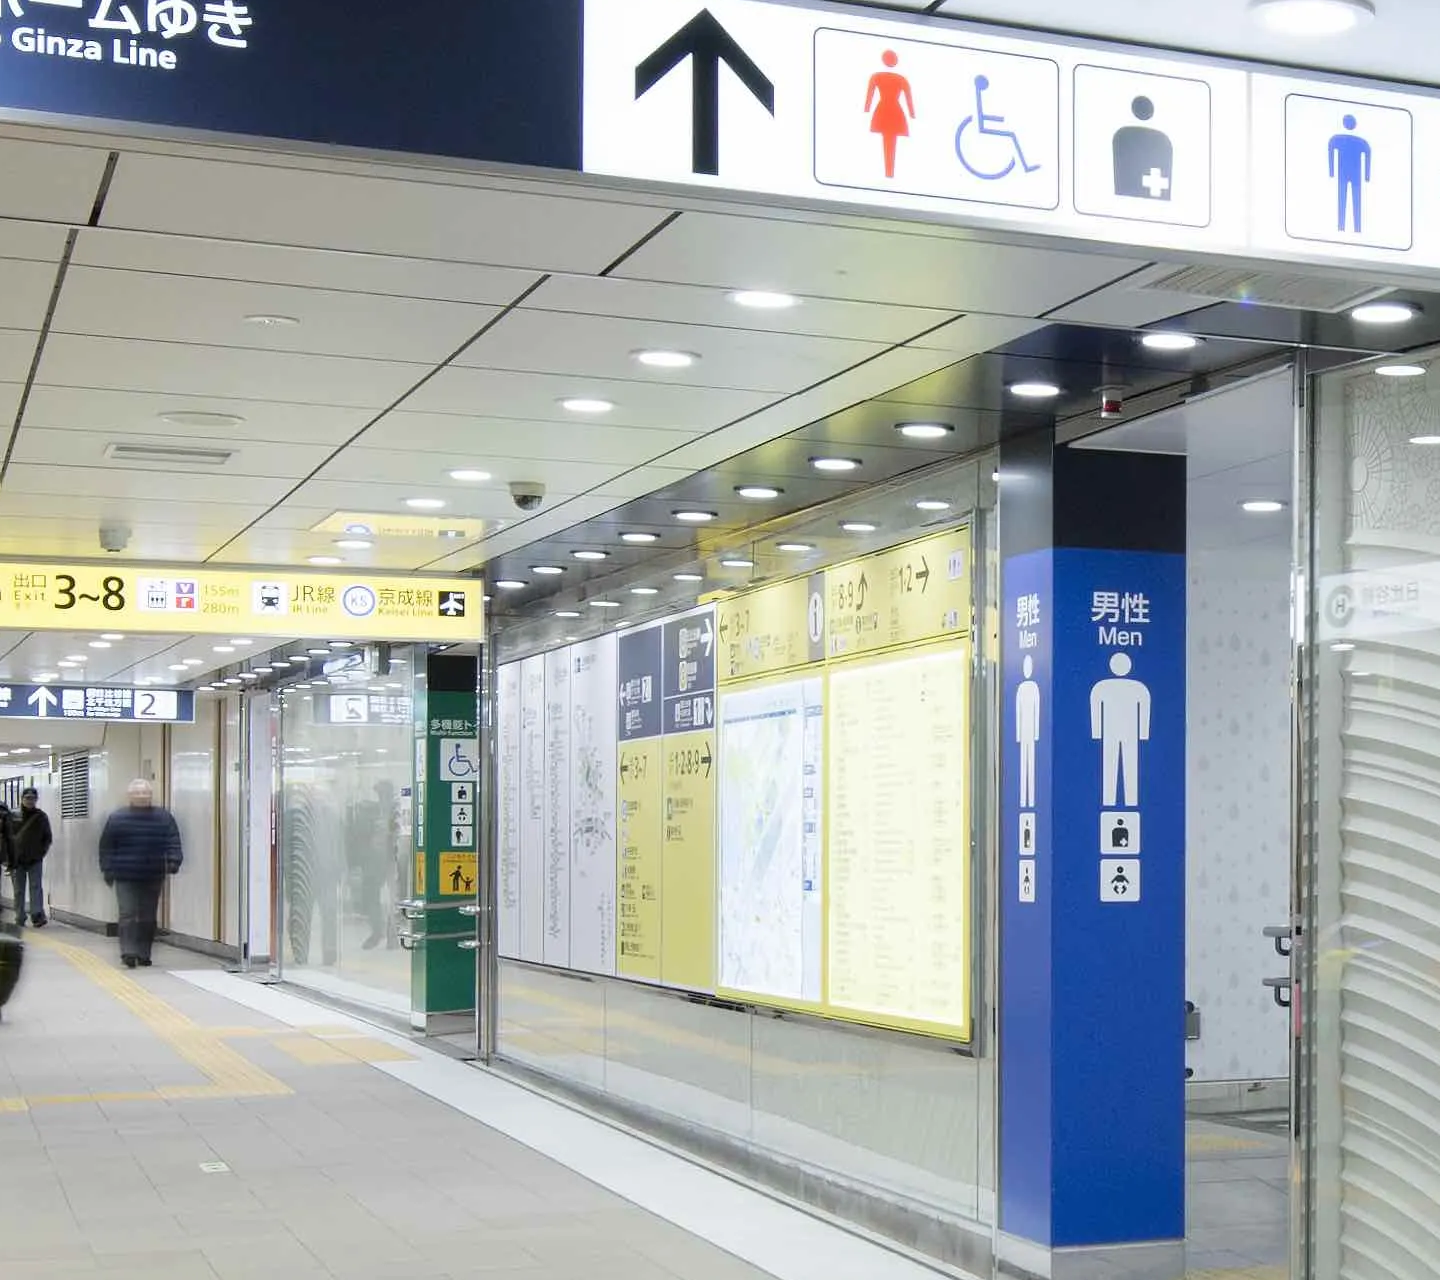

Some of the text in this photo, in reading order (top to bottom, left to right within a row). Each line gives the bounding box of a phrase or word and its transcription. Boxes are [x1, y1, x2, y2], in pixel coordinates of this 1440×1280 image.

[11, 27, 103, 62] Ginza
[112, 39, 178, 71] Line
[14, 573, 47, 588] 出口
[14, 589, 46, 601] Exit
[292, 584, 336, 604] JR線
[378, 588, 433, 607] 京成線
[1016, 593, 1040, 628] 男性
[1090, 591, 1151, 624] 男性
[1019, 630, 1038, 649] Men
[1098, 626, 1143, 646] Men
[140, 692, 157, 716] 2
